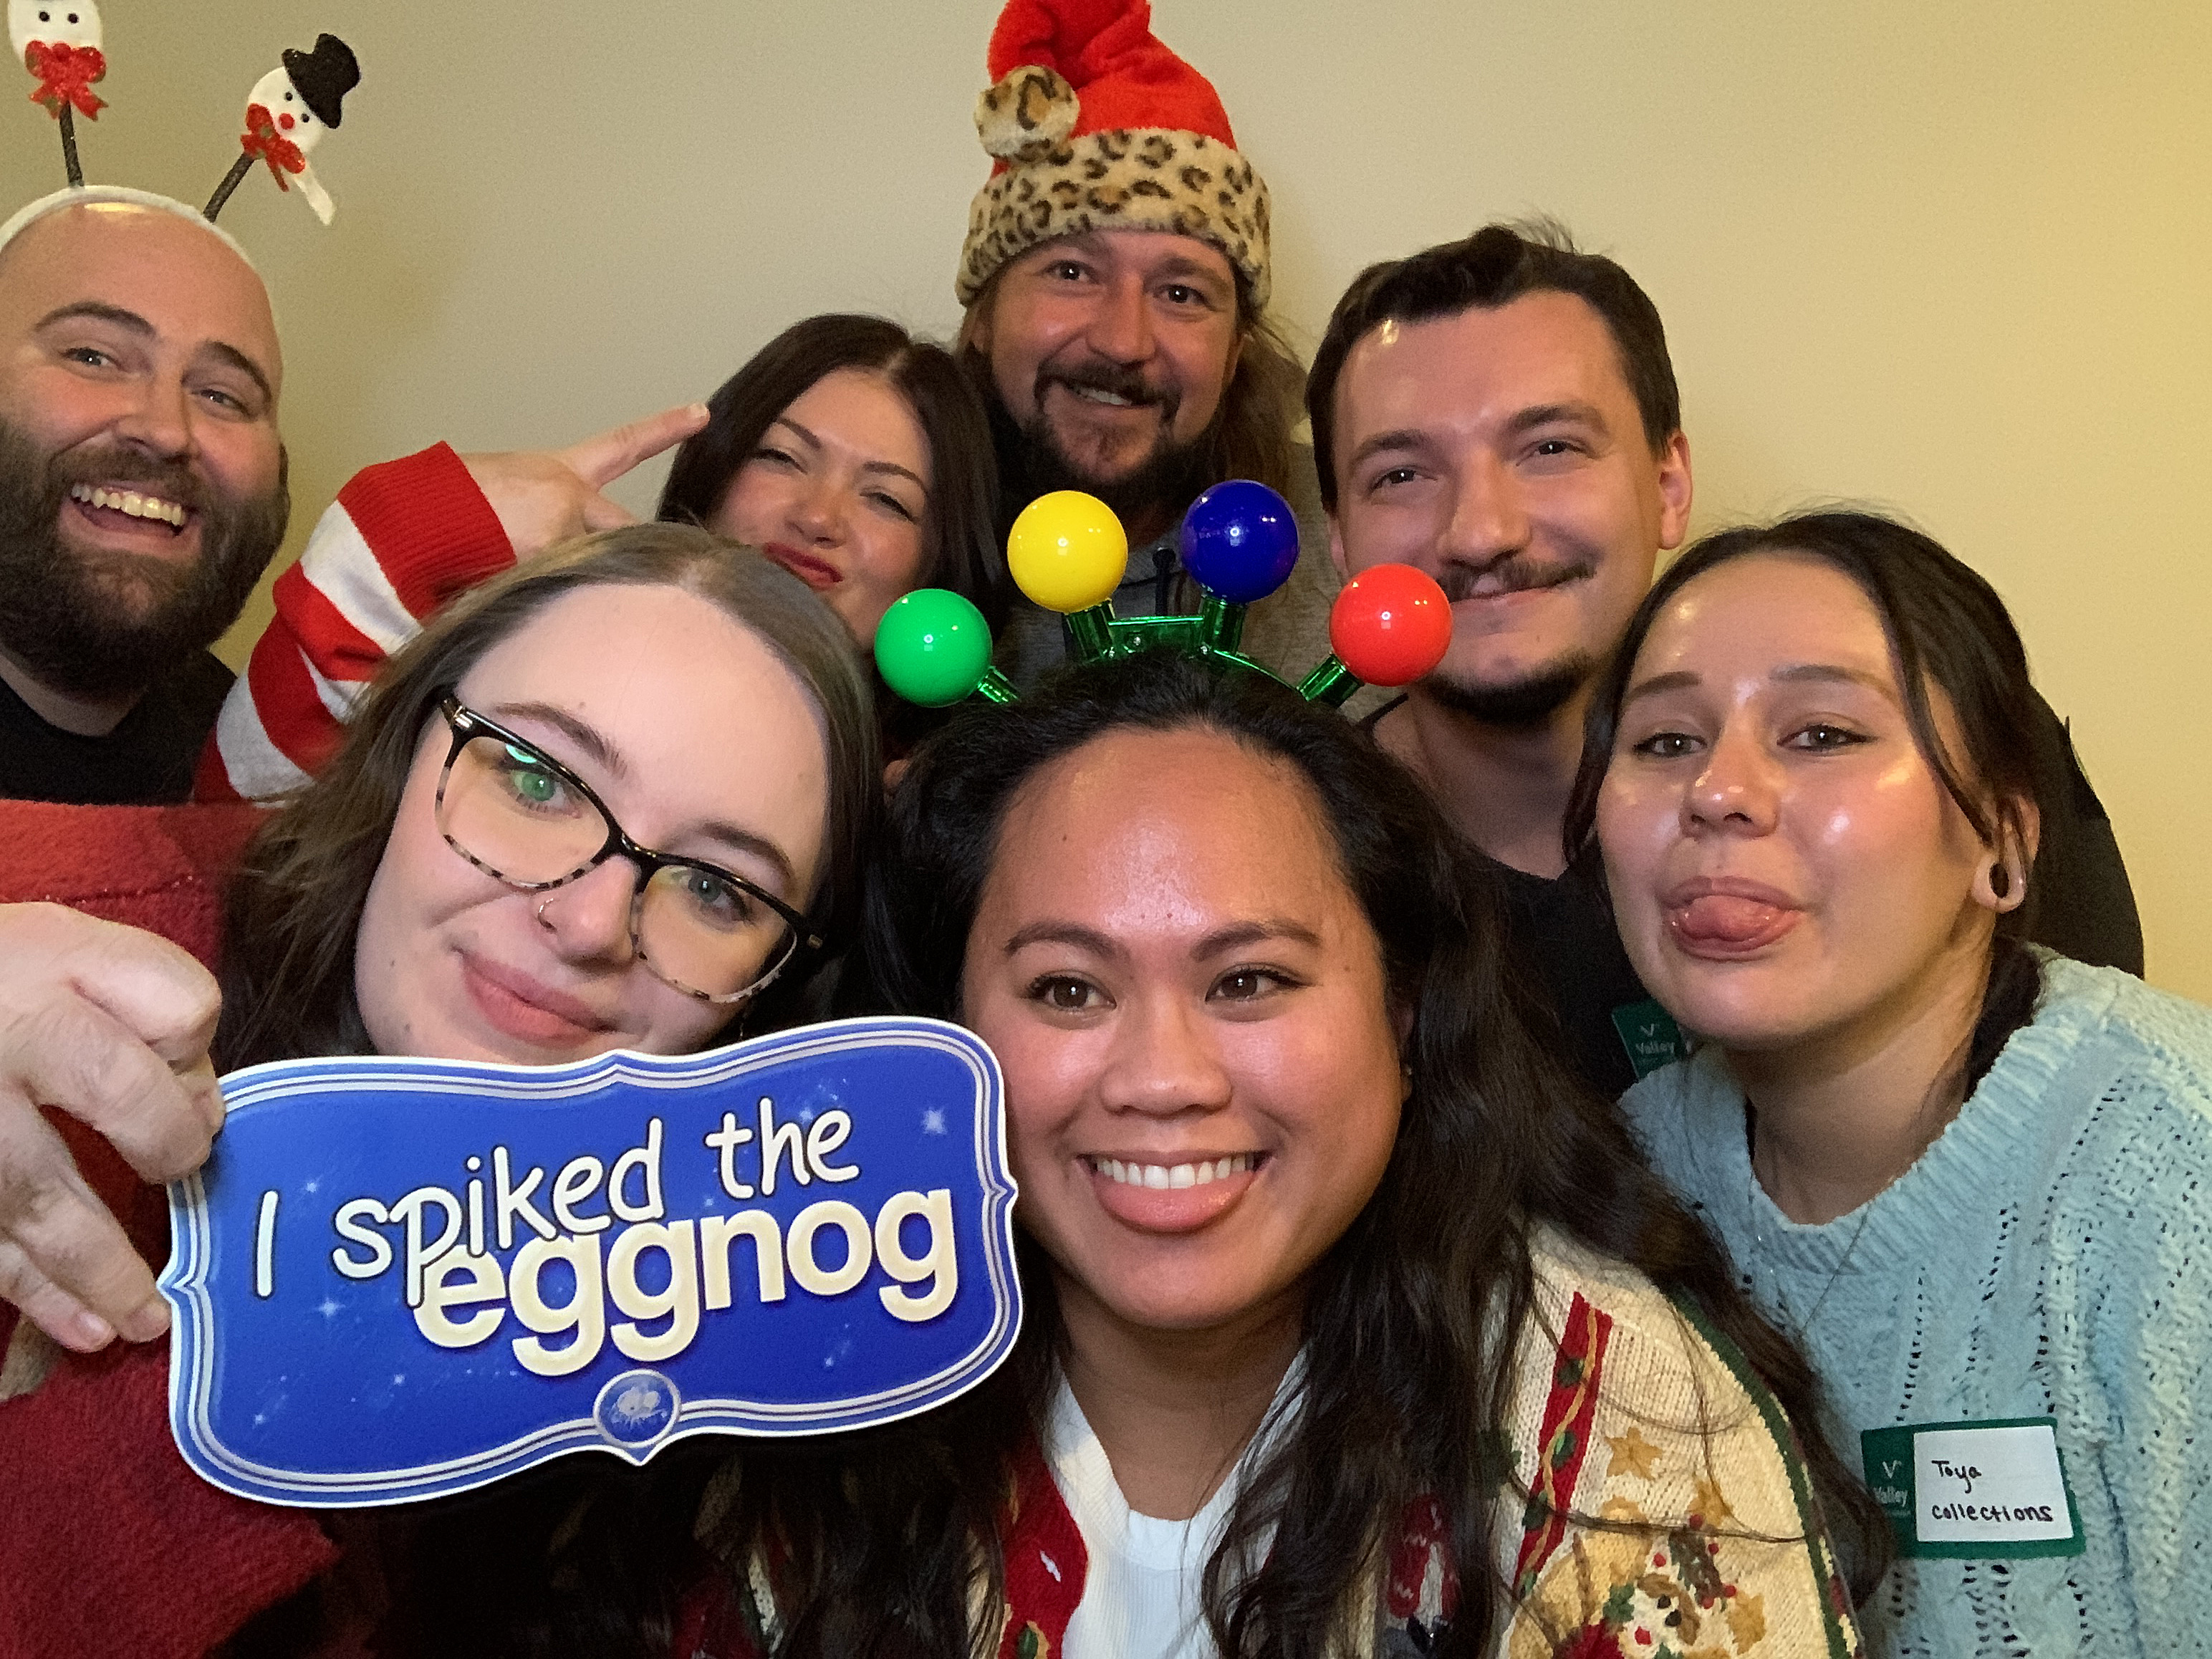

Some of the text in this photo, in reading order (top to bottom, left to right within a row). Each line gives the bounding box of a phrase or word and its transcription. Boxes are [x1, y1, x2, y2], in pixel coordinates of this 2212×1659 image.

[1635, 1042, 1675, 1055] Valley
[256, 1097, 860, 1307] I spiked the
[413, 1188, 958, 1376] eggnog
[1932, 1460, 1981, 1494] Toya
[1873, 1486, 1908, 1507] Valley
